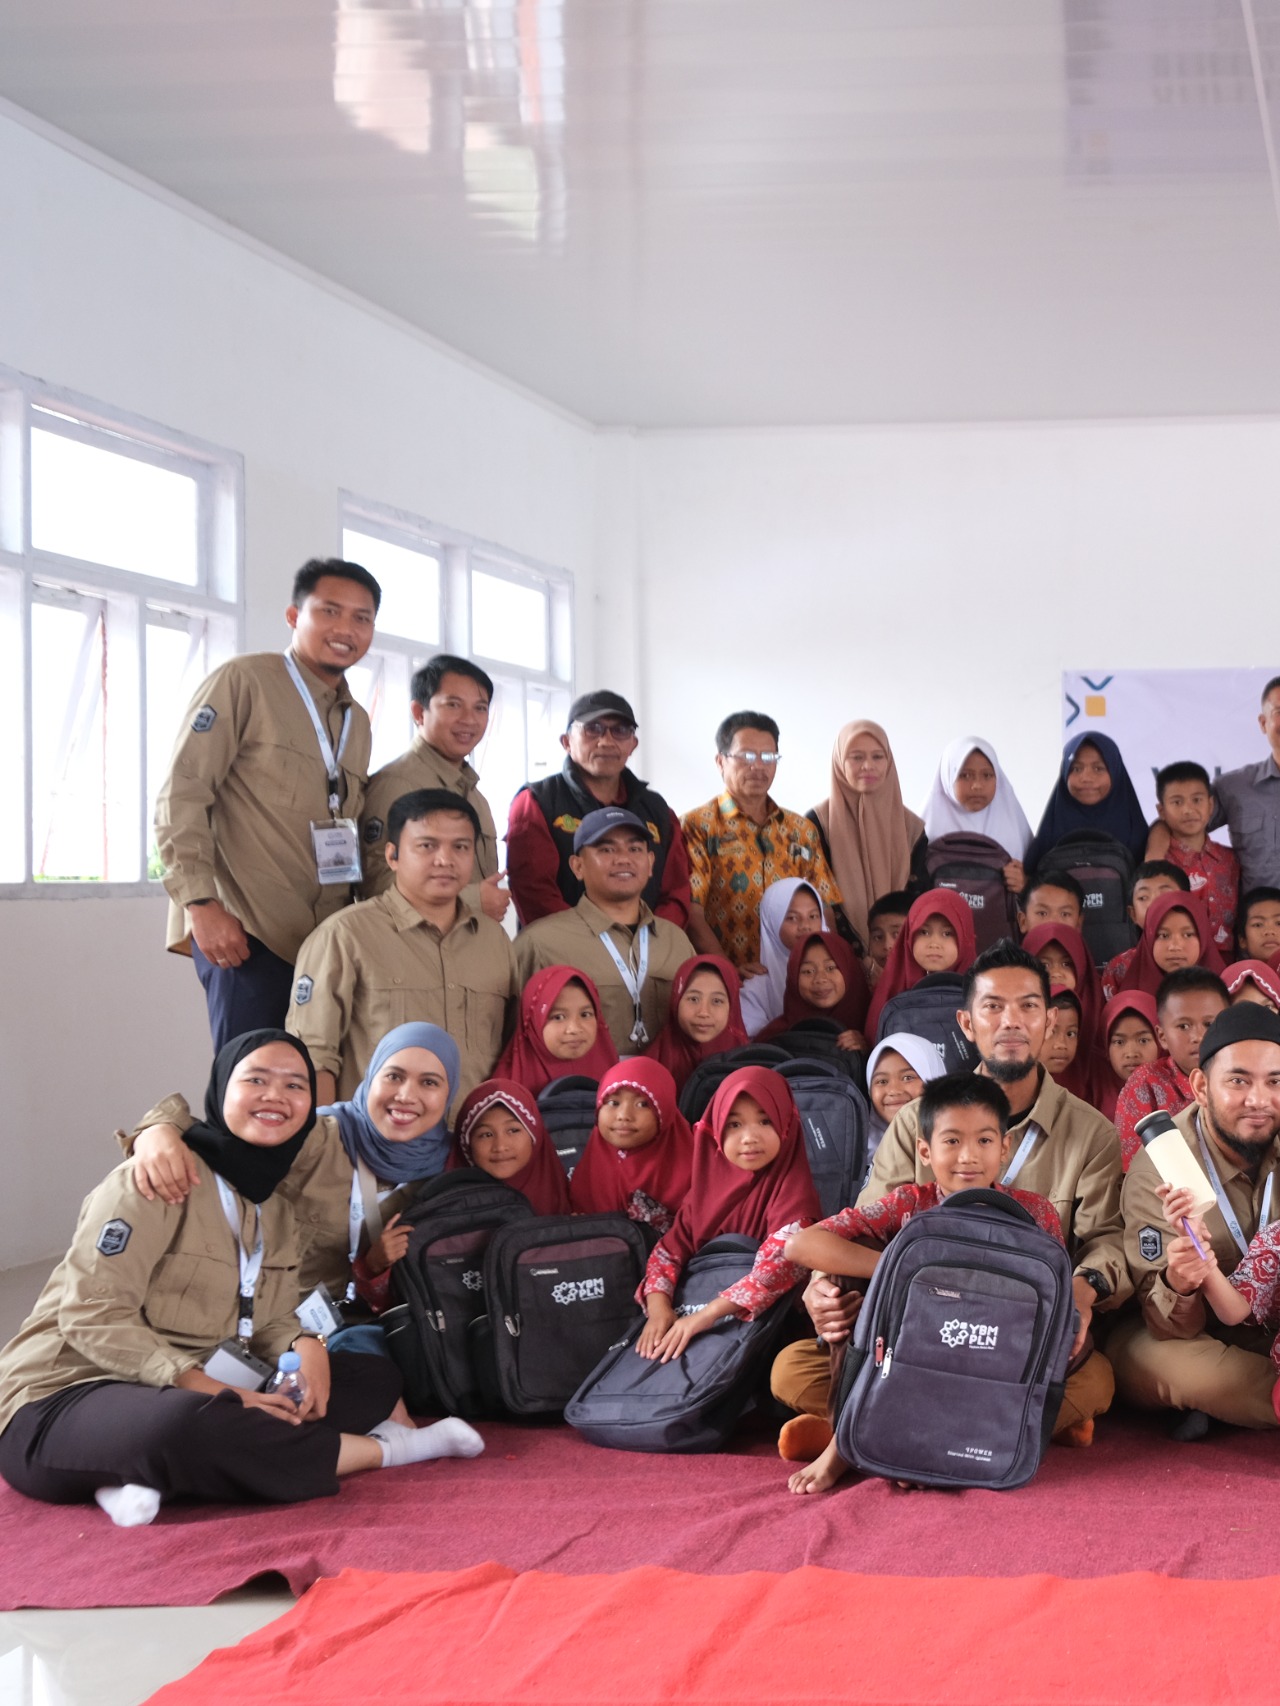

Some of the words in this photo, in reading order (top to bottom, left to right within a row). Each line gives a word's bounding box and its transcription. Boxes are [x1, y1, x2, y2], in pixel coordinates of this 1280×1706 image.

[576, 1277, 604, 1289] YBM
[579, 1286, 605, 1298] PLN
[969, 1323, 999, 1336] YBM
[968, 1334, 998, 1347] PLN
